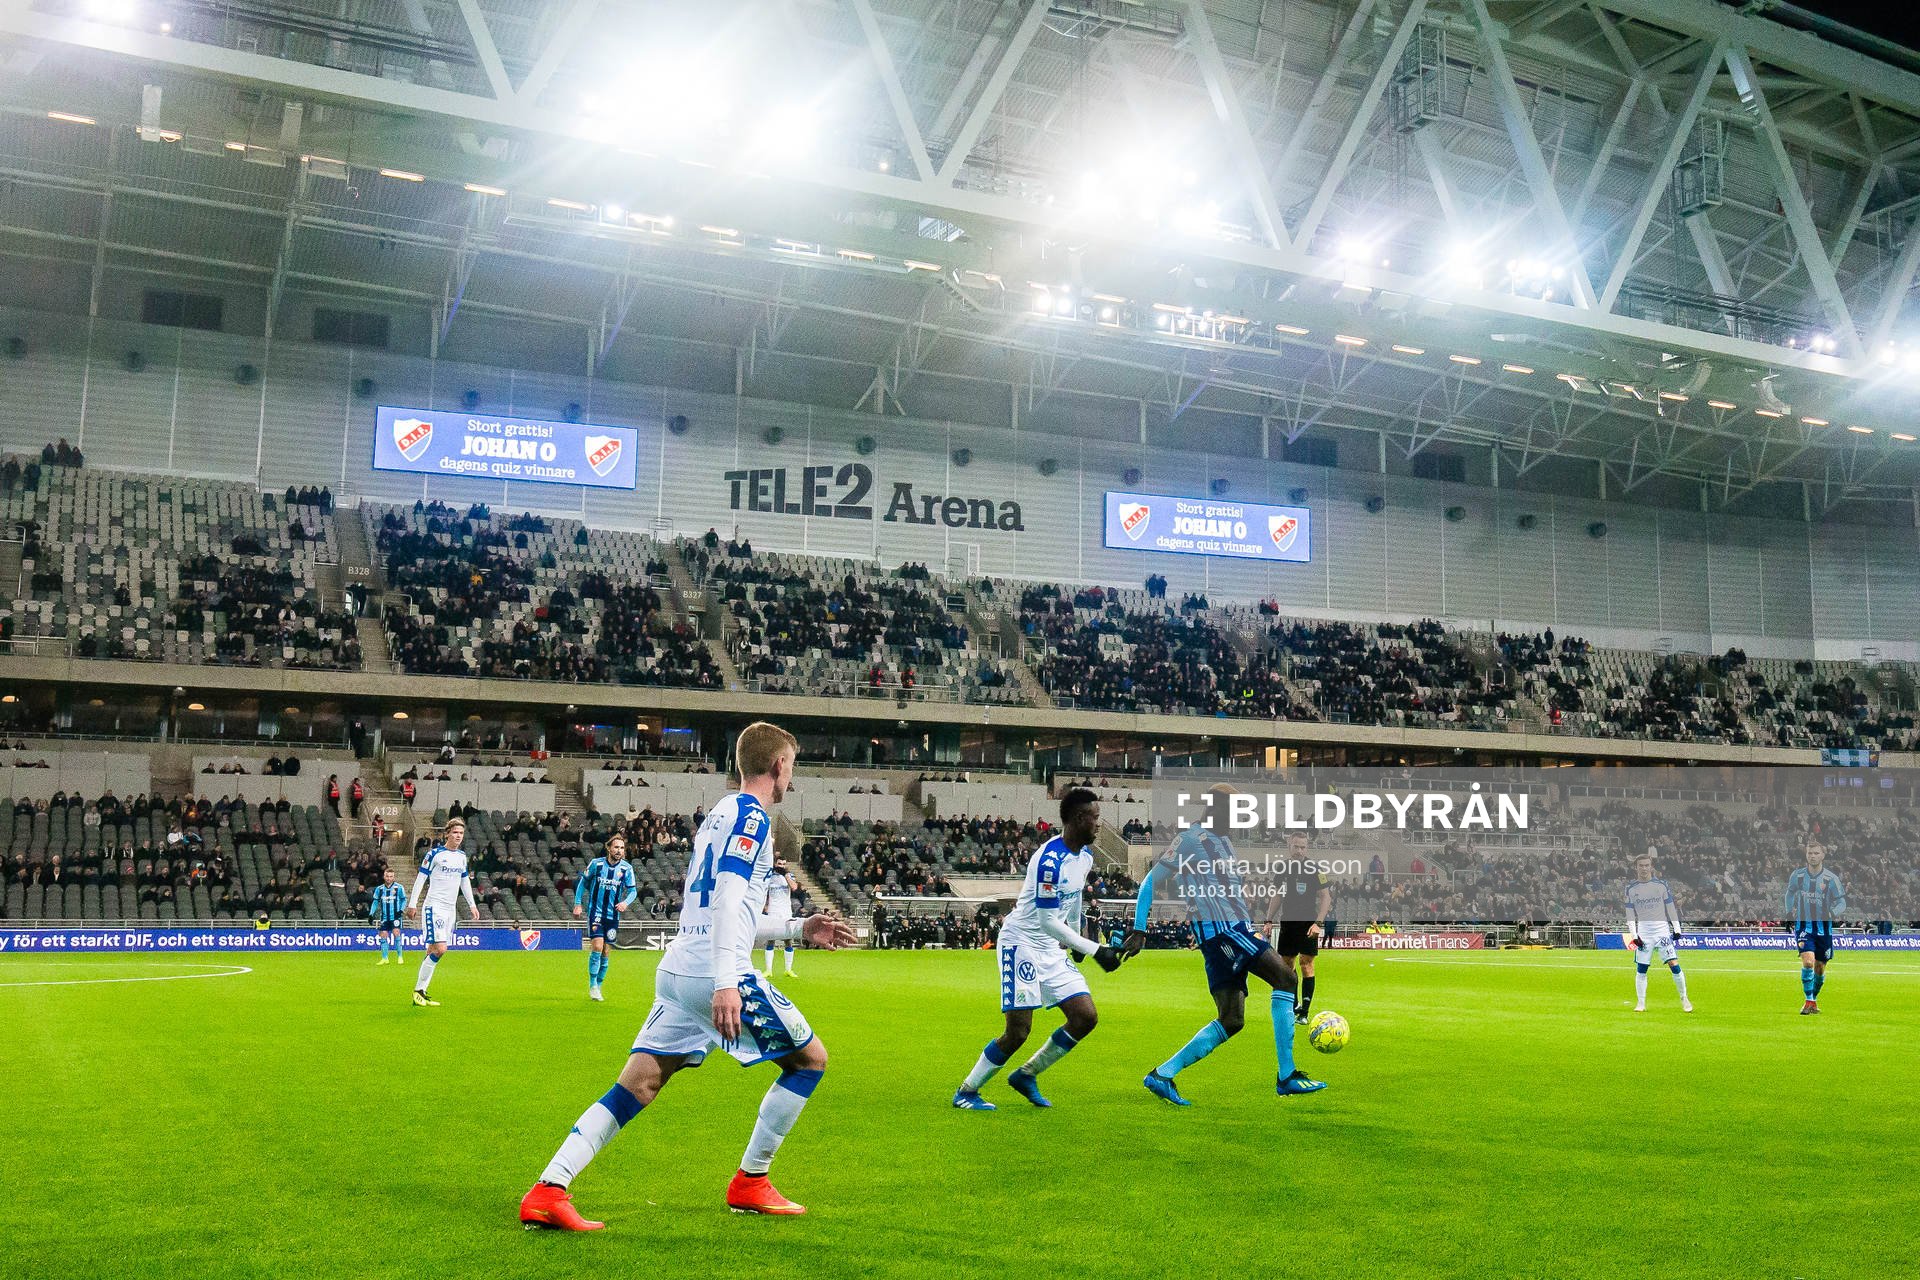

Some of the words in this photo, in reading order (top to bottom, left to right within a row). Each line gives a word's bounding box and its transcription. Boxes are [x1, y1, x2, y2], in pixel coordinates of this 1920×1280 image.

[467, 420, 501, 434] Stort
[504, 423, 553, 438] grattis!
[461, 436, 537, 460] JOHAN
[540, 443, 557, 461] O
[439, 457, 489, 473] dagens
[492, 462, 521, 476] quiz
[524, 465, 576, 479] vinnare
[724, 463, 873, 520] TELE2
[883, 482, 1025, 532] Arena
[1176, 503, 1203, 515] Stort
[1206, 505, 1244, 519] grattis!
[1172, 517, 1231, 538] JOHAN
[1234, 522, 1247, 539] O
[1156, 536, 1194, 550] dagens
[1197, 540, 1220, 552] quiz
[1222, 542, 1263, 554] vinnare
[348, 566, 370, 576] B328
[371, 806, 399, 816] A128
[13, 934, 37, 947] för
[42, 934, 66, 947] ett
[70, 934, 120, 947] starkt
[125, 934, 154, 948] DIF,
[158, 934, 187, 947] och
[191, 935, 215, 946] ett
[219, 934, 266, 946] starkt
[270, 933, 351, 946] Stockholm
[1344, 938, 1371, 948] Finans
[1372, 934, 1427, 948] Prioritet
[1429, 935, 1469, 949] Finans
[1679, 936, 1697, 946] stad
[1704, 936, 1732, 946] fotboll
[1734, 936, 1750, 946] och
[1788, 936, 1798, 946] fö
[1840, 938, 1856, 948] DIF,
[1856, 937, 1871, 947] och
[1872, 938, 1884, 947] ett
[1885, 938, 1909, 947] starkt
